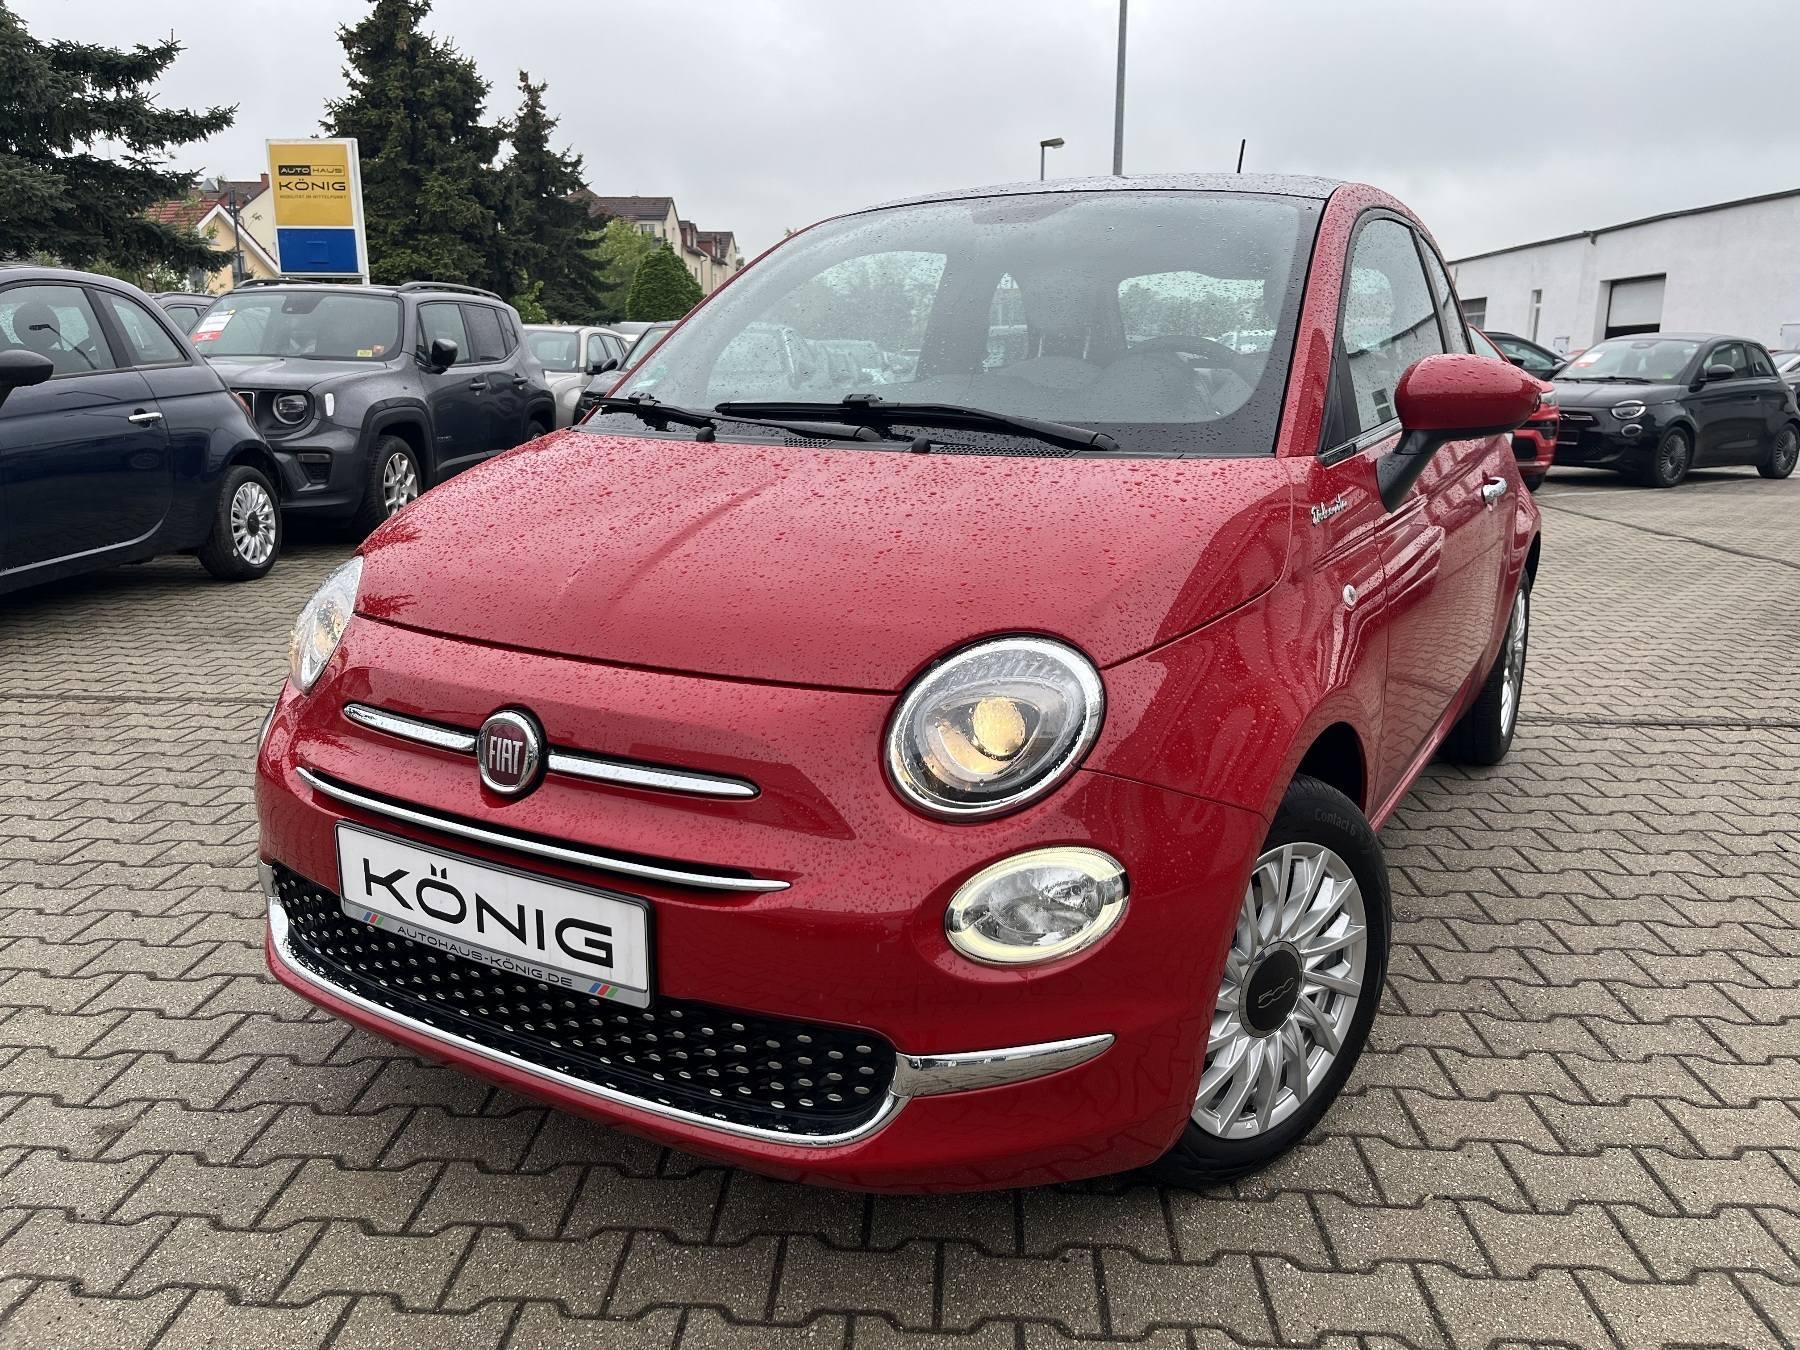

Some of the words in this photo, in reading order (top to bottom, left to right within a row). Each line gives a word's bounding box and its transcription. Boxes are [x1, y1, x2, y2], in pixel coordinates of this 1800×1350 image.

[278, 178, 346, 191] KÖNIG
[488, 735, 524, 775] FIAT
[1314, 808, 1350, 832] Contact
[362, 857, 614, 969] KÖNIG
[396, 925, 574, 988] AUTOHAUS-KÖNIG.DE
